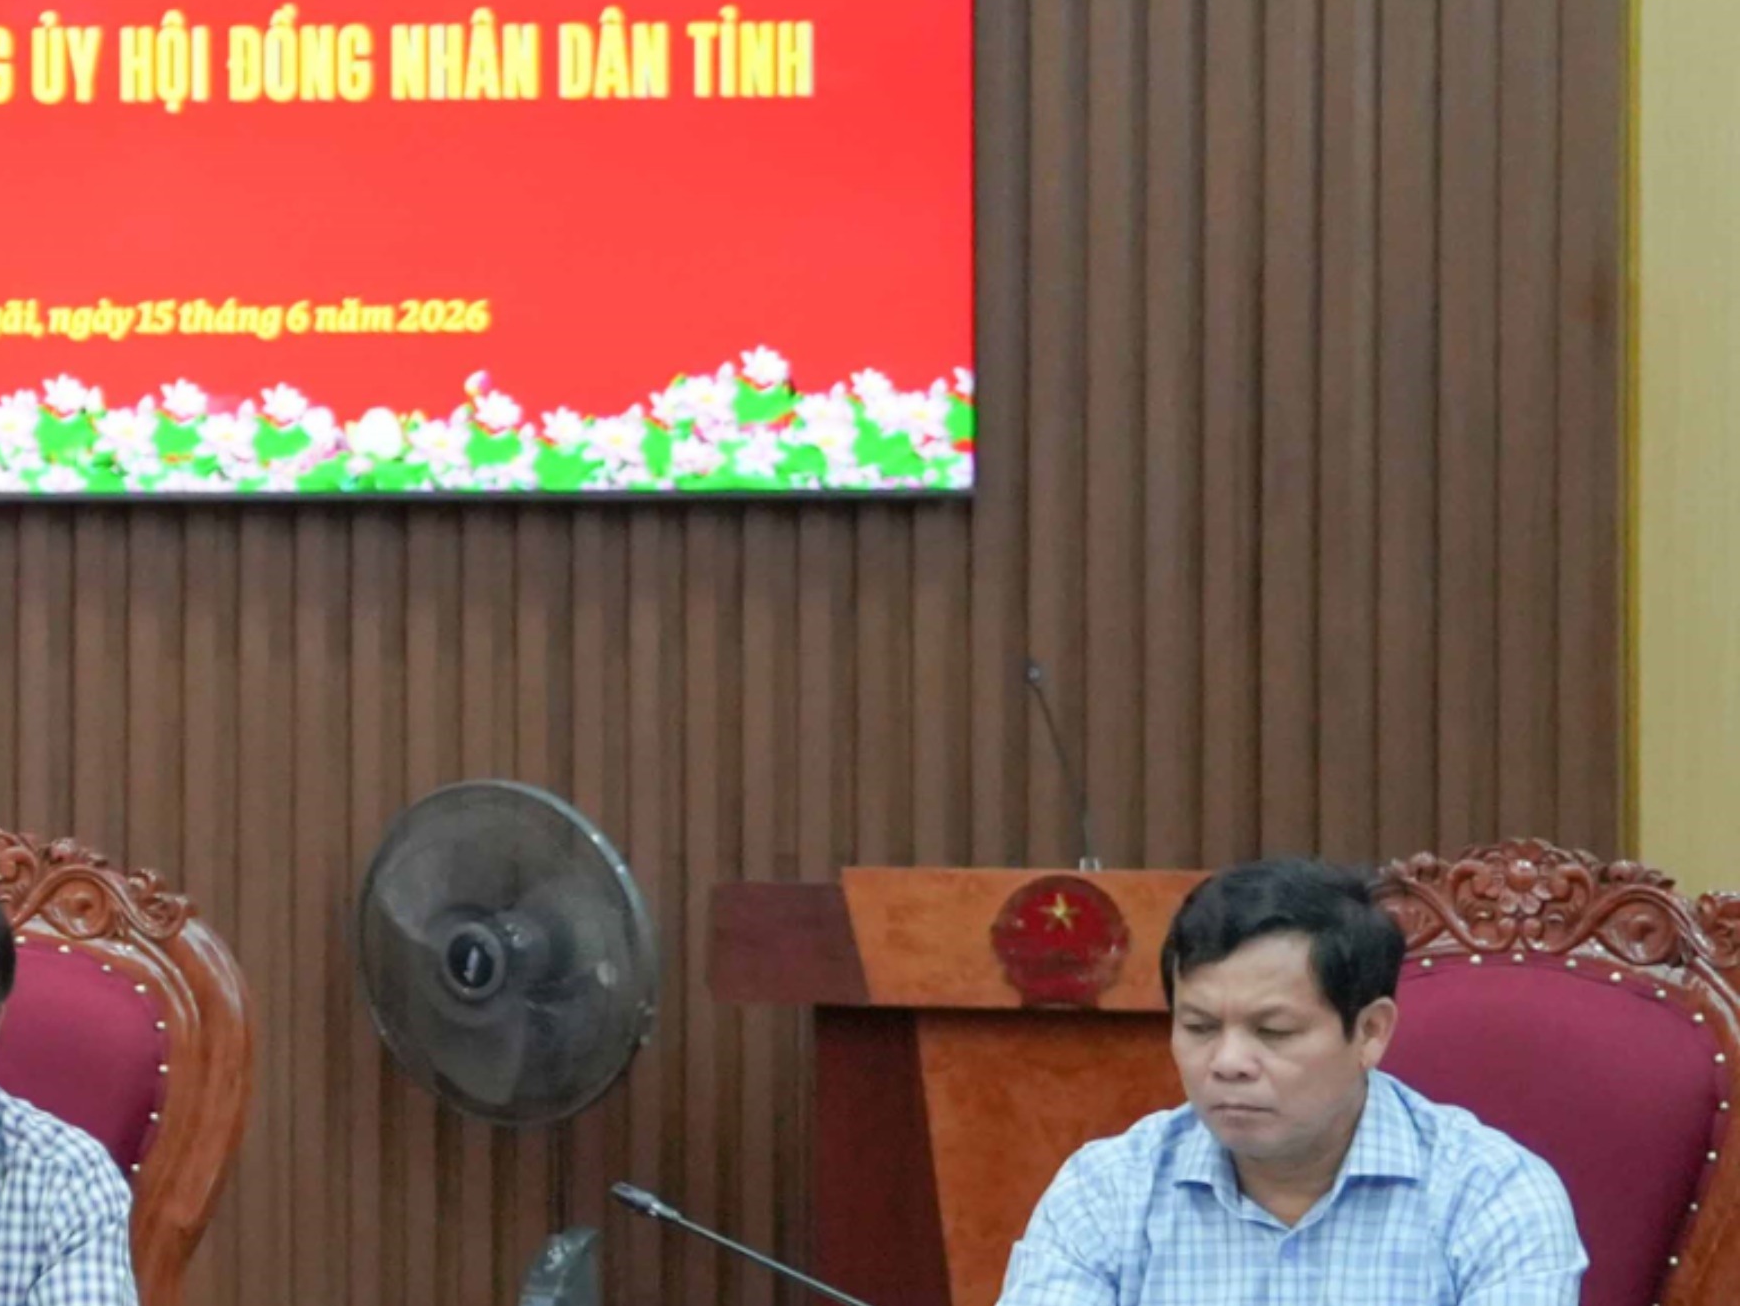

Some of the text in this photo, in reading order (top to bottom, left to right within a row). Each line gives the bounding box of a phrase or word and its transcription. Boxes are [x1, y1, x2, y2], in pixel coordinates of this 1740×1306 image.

[31, 10, 101, 104] ỦY
[119, 10, 210, 113] HỘI
[228, 4, 373, 102] ĐỒNG
[391, 7, 539, 100] NHÂN
[559, 6, 669, 99] DÂN
[686, 6, 814, 97] TỈNH
[50, 298, 133, 342] ngày
[135, 299, 175, 334] 15
[179, 297, 283, 340] tháng
[287, 300, 309, 333] 6
[315, 297, 392, 333] năm
[398, 299, 489, 333] 2026
